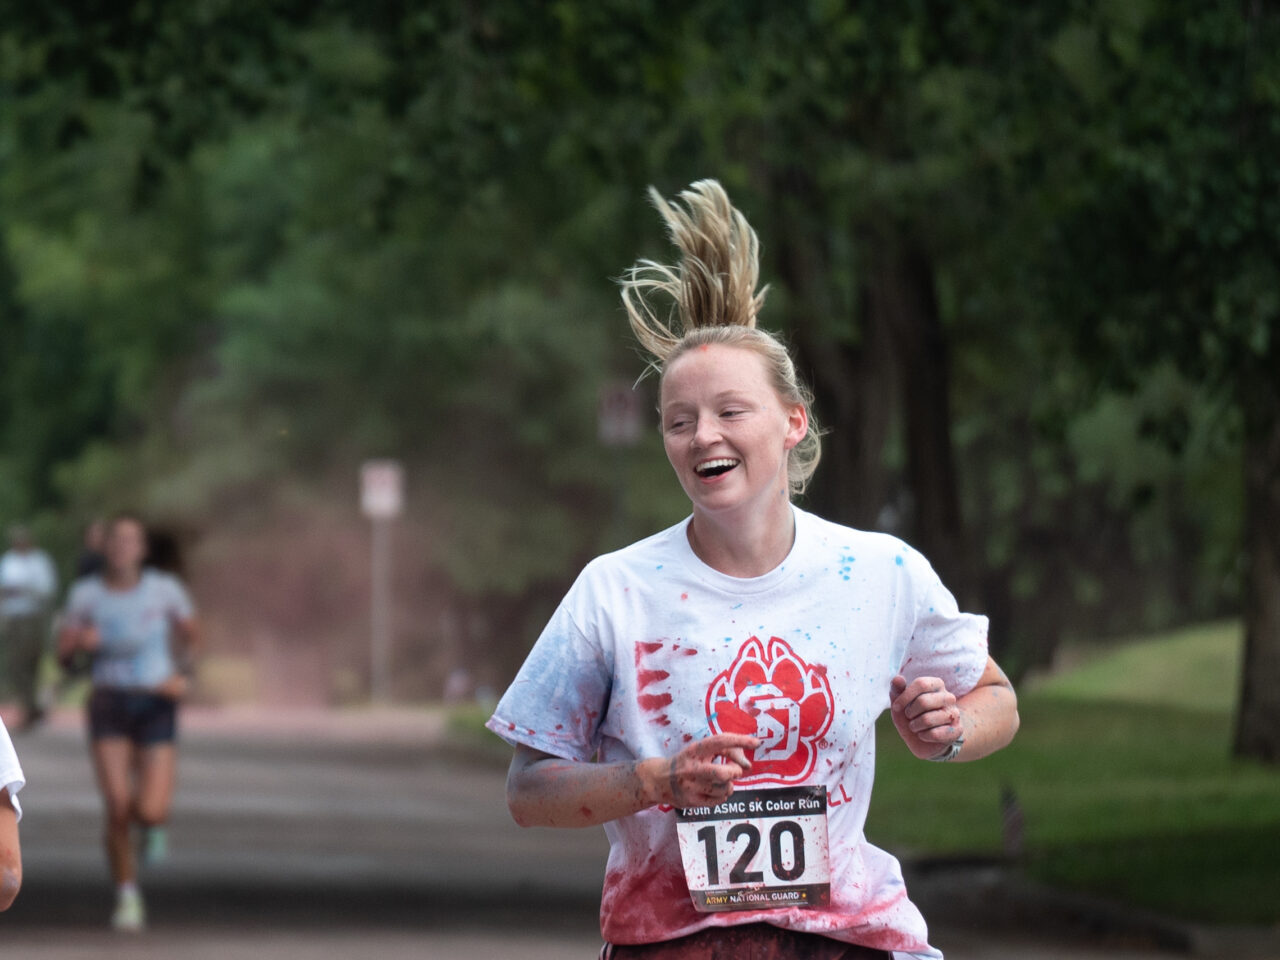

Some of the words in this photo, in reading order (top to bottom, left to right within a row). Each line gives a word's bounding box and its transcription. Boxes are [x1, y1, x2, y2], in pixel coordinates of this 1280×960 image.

[714, 801, 746, 814] ASMC
[749, 799, 764, 813] 5K
[766, 797, 795, 812] Color
[798, 795, 820, 809] Run
[697, 820, 806, 886] 120
[706, 896, 728, 905] ARMY
[730, 893, 769, 904] NATIONAL
[771, 891, 800, 901] GUARD
